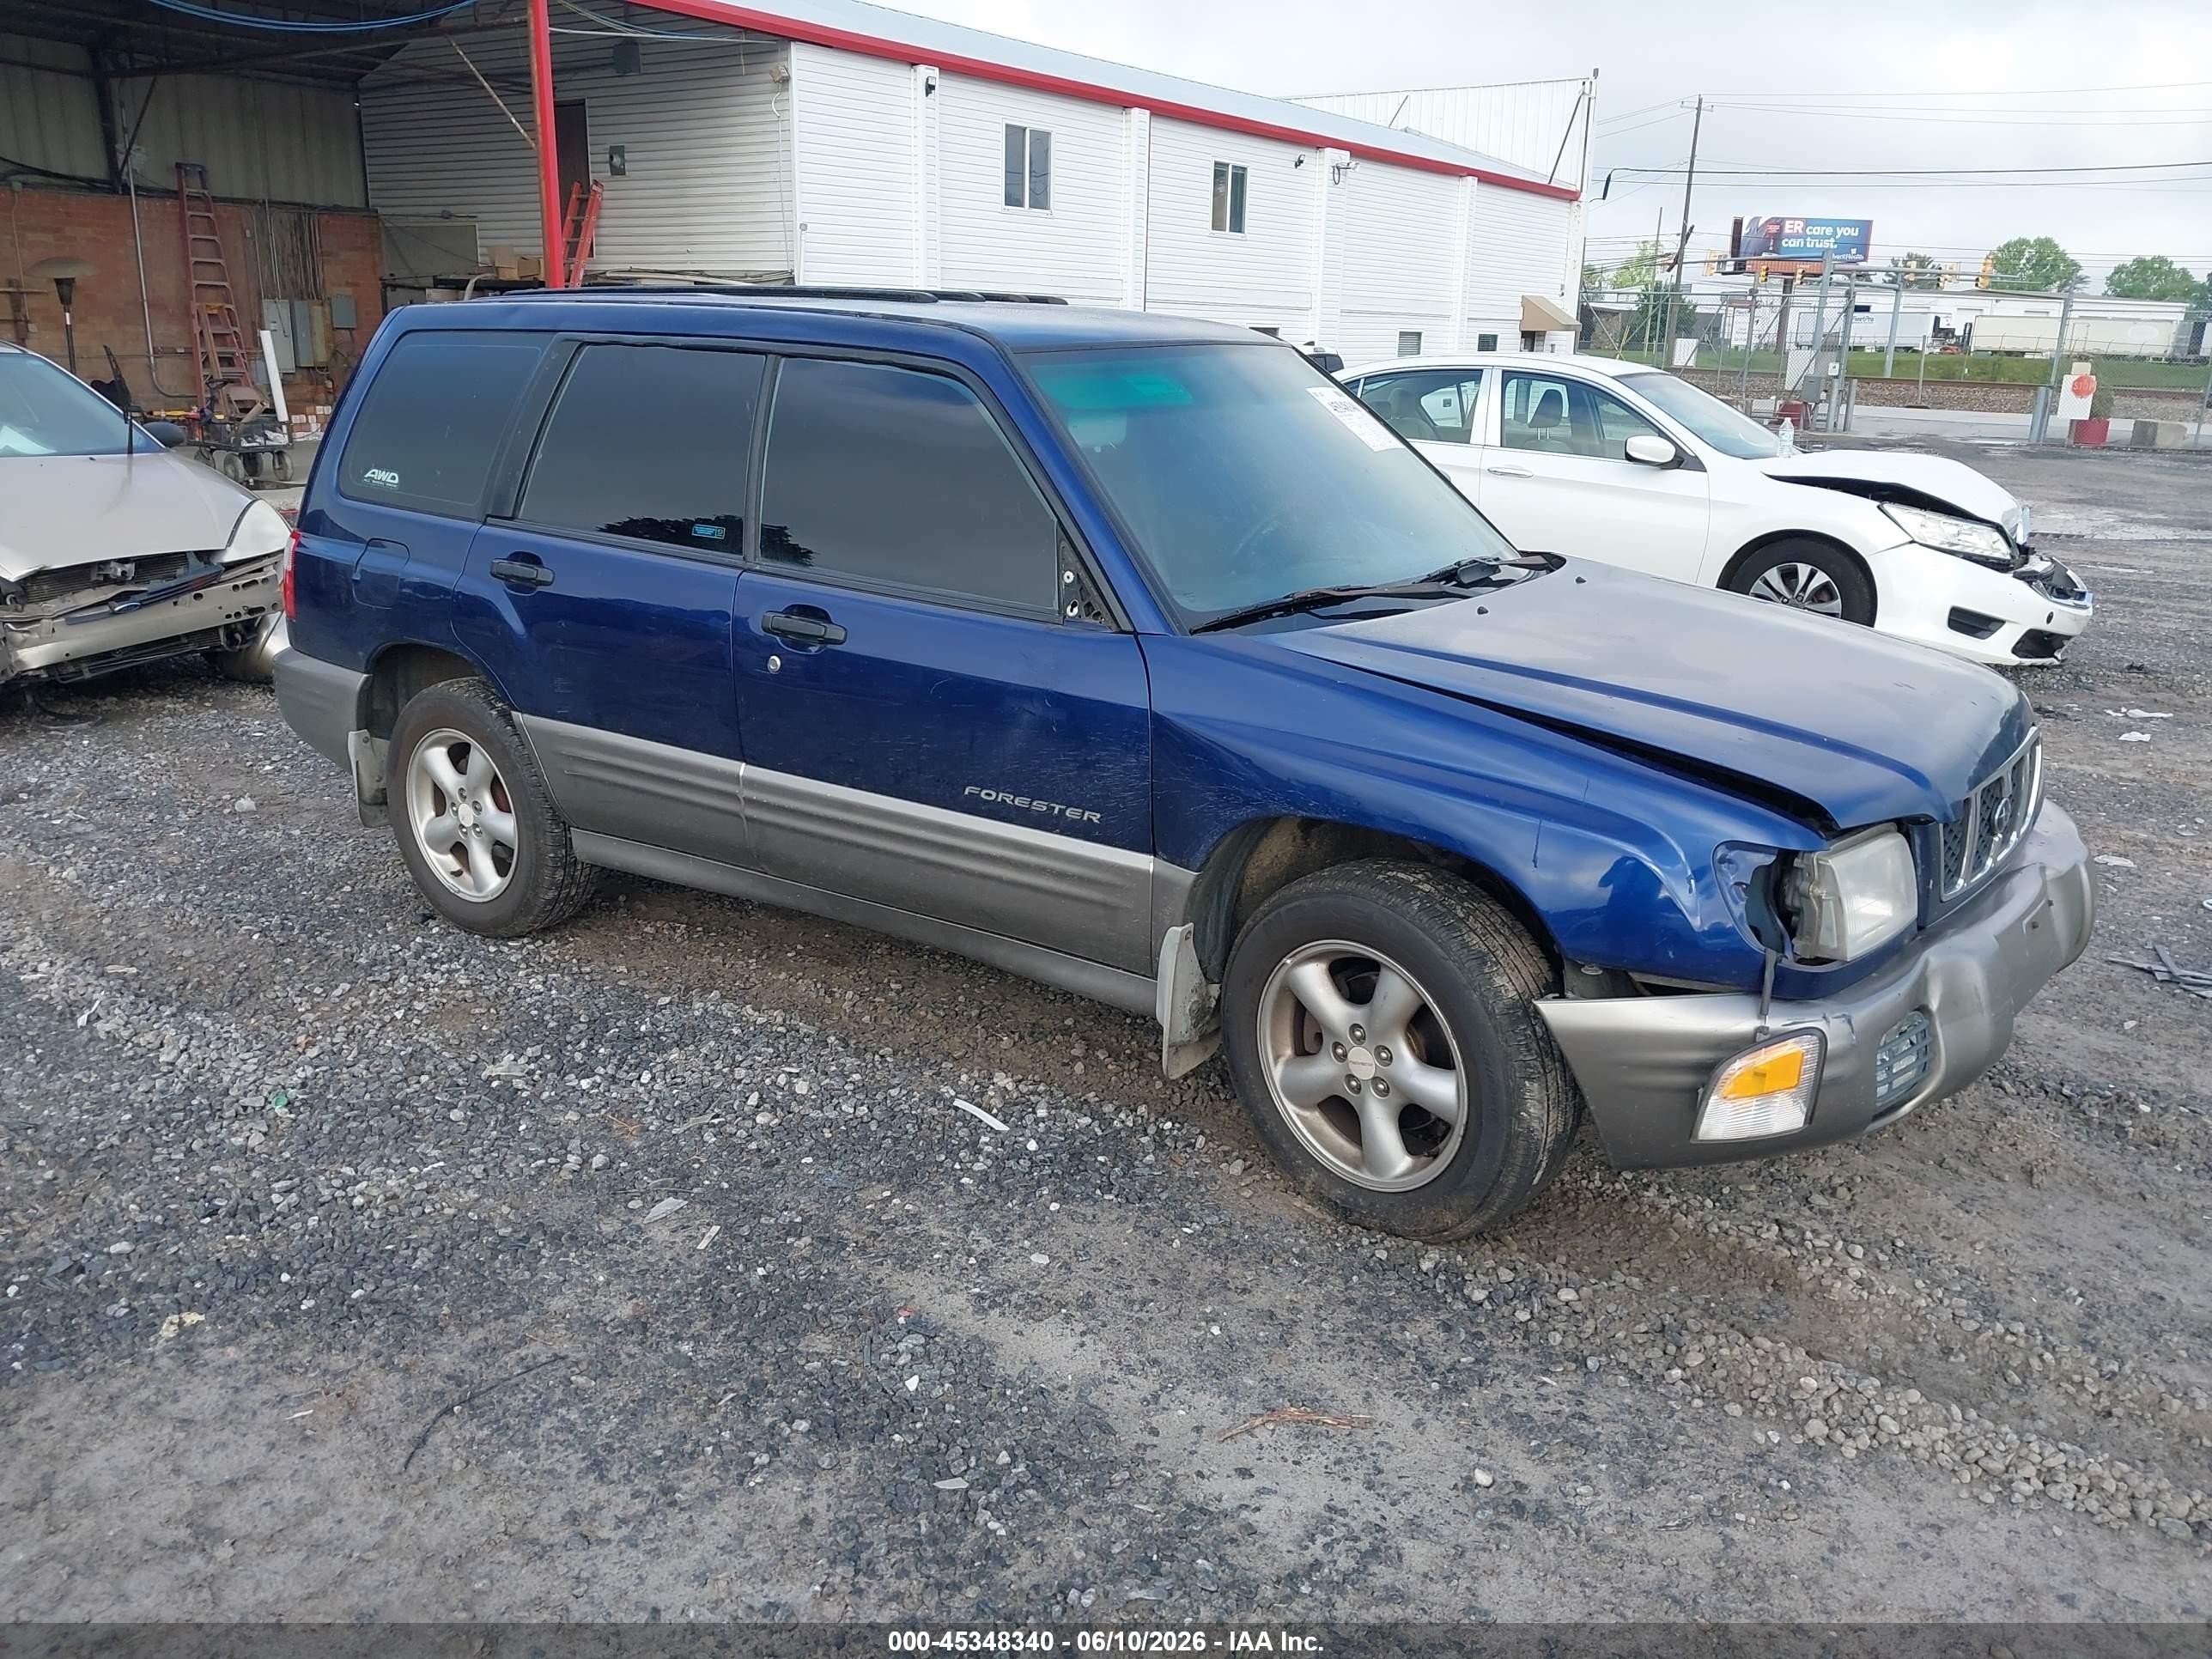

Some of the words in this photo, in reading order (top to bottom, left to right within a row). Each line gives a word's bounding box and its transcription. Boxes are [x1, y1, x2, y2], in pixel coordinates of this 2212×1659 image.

[1784, 220, 1803, 234] ER
[1806, 226, 1833, 236] care
[1835, 225, 1859, 239] you
[1781, 238, 1805, 248] can
[1806, 237, 1838, 249] trust.
[364, 469, 399, 483] AWD
[963, 786, 1102, 823] FORESTER
